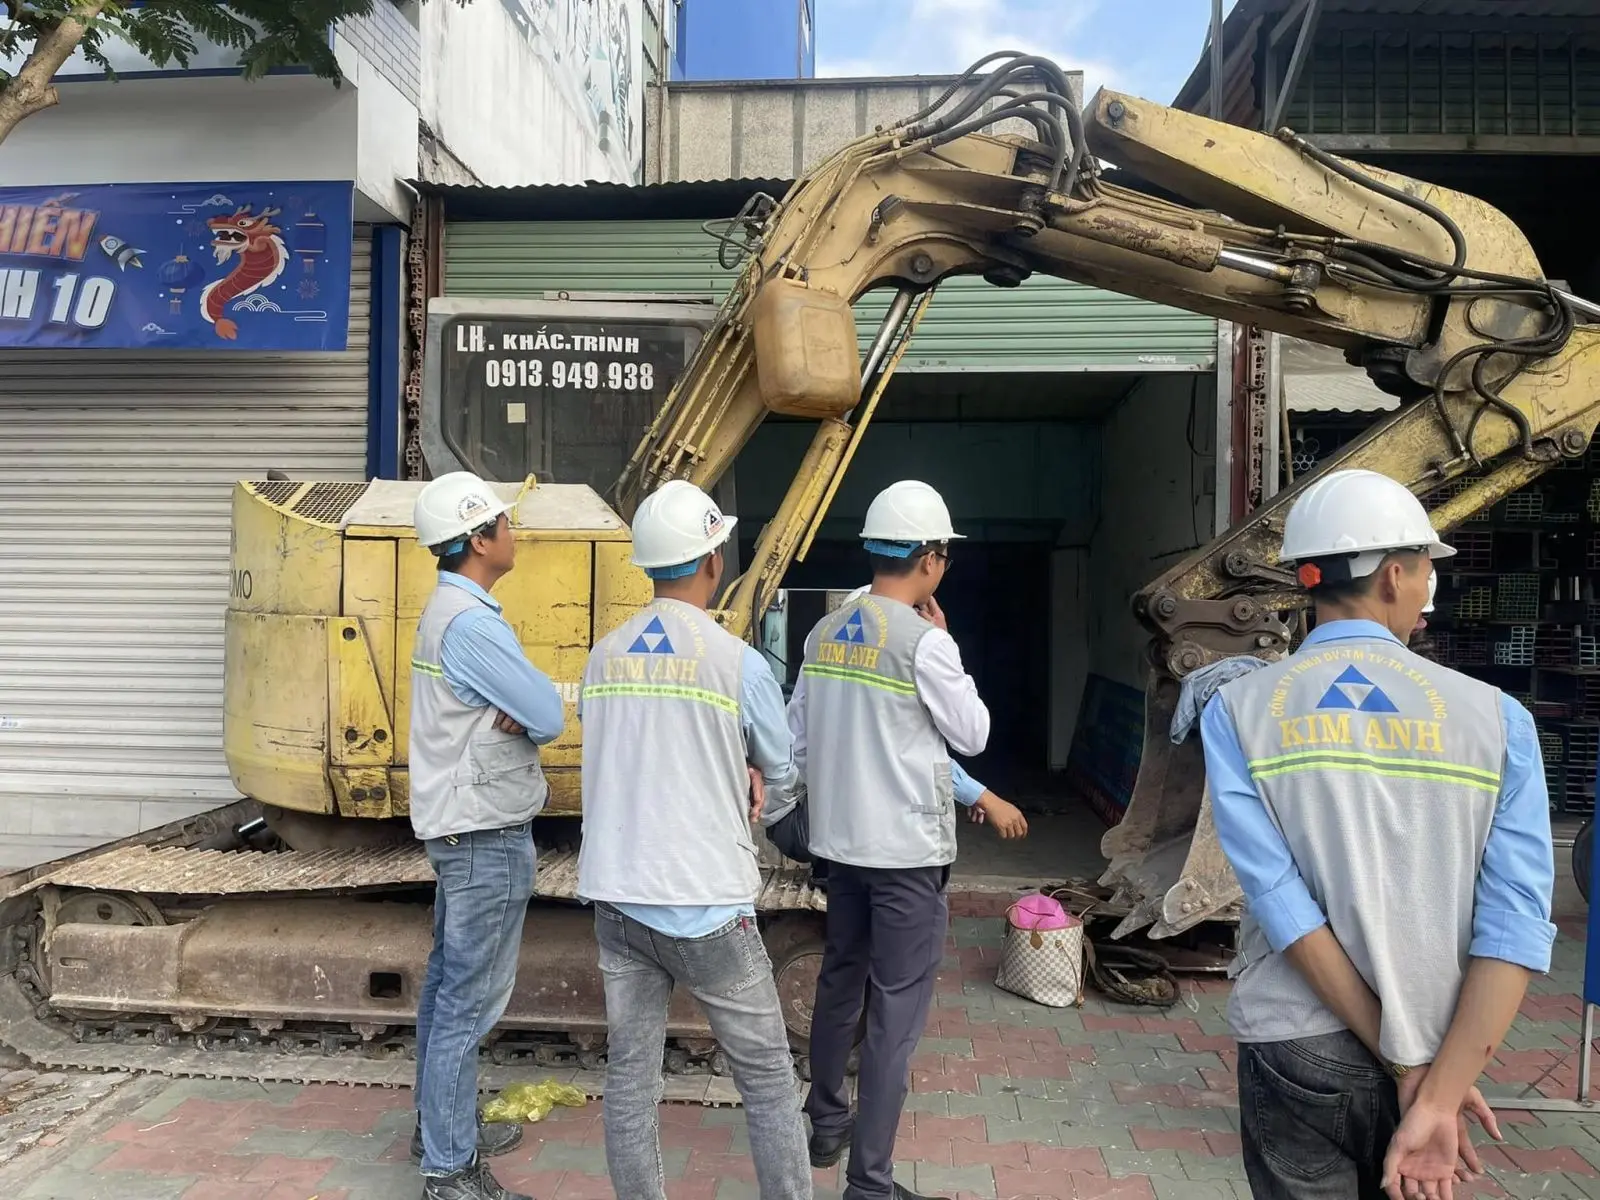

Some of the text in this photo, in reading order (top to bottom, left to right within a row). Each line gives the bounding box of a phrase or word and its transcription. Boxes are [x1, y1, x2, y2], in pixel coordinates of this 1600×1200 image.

[51, 274, 115, 327] 10
[485, 359, 655, 391] 0913.949.938
[605, 656, 699, 682] KIM ANH
[816, 642, 880, 670] KIM ANH
[1278, 713, 1445, 753] KIM ANH
